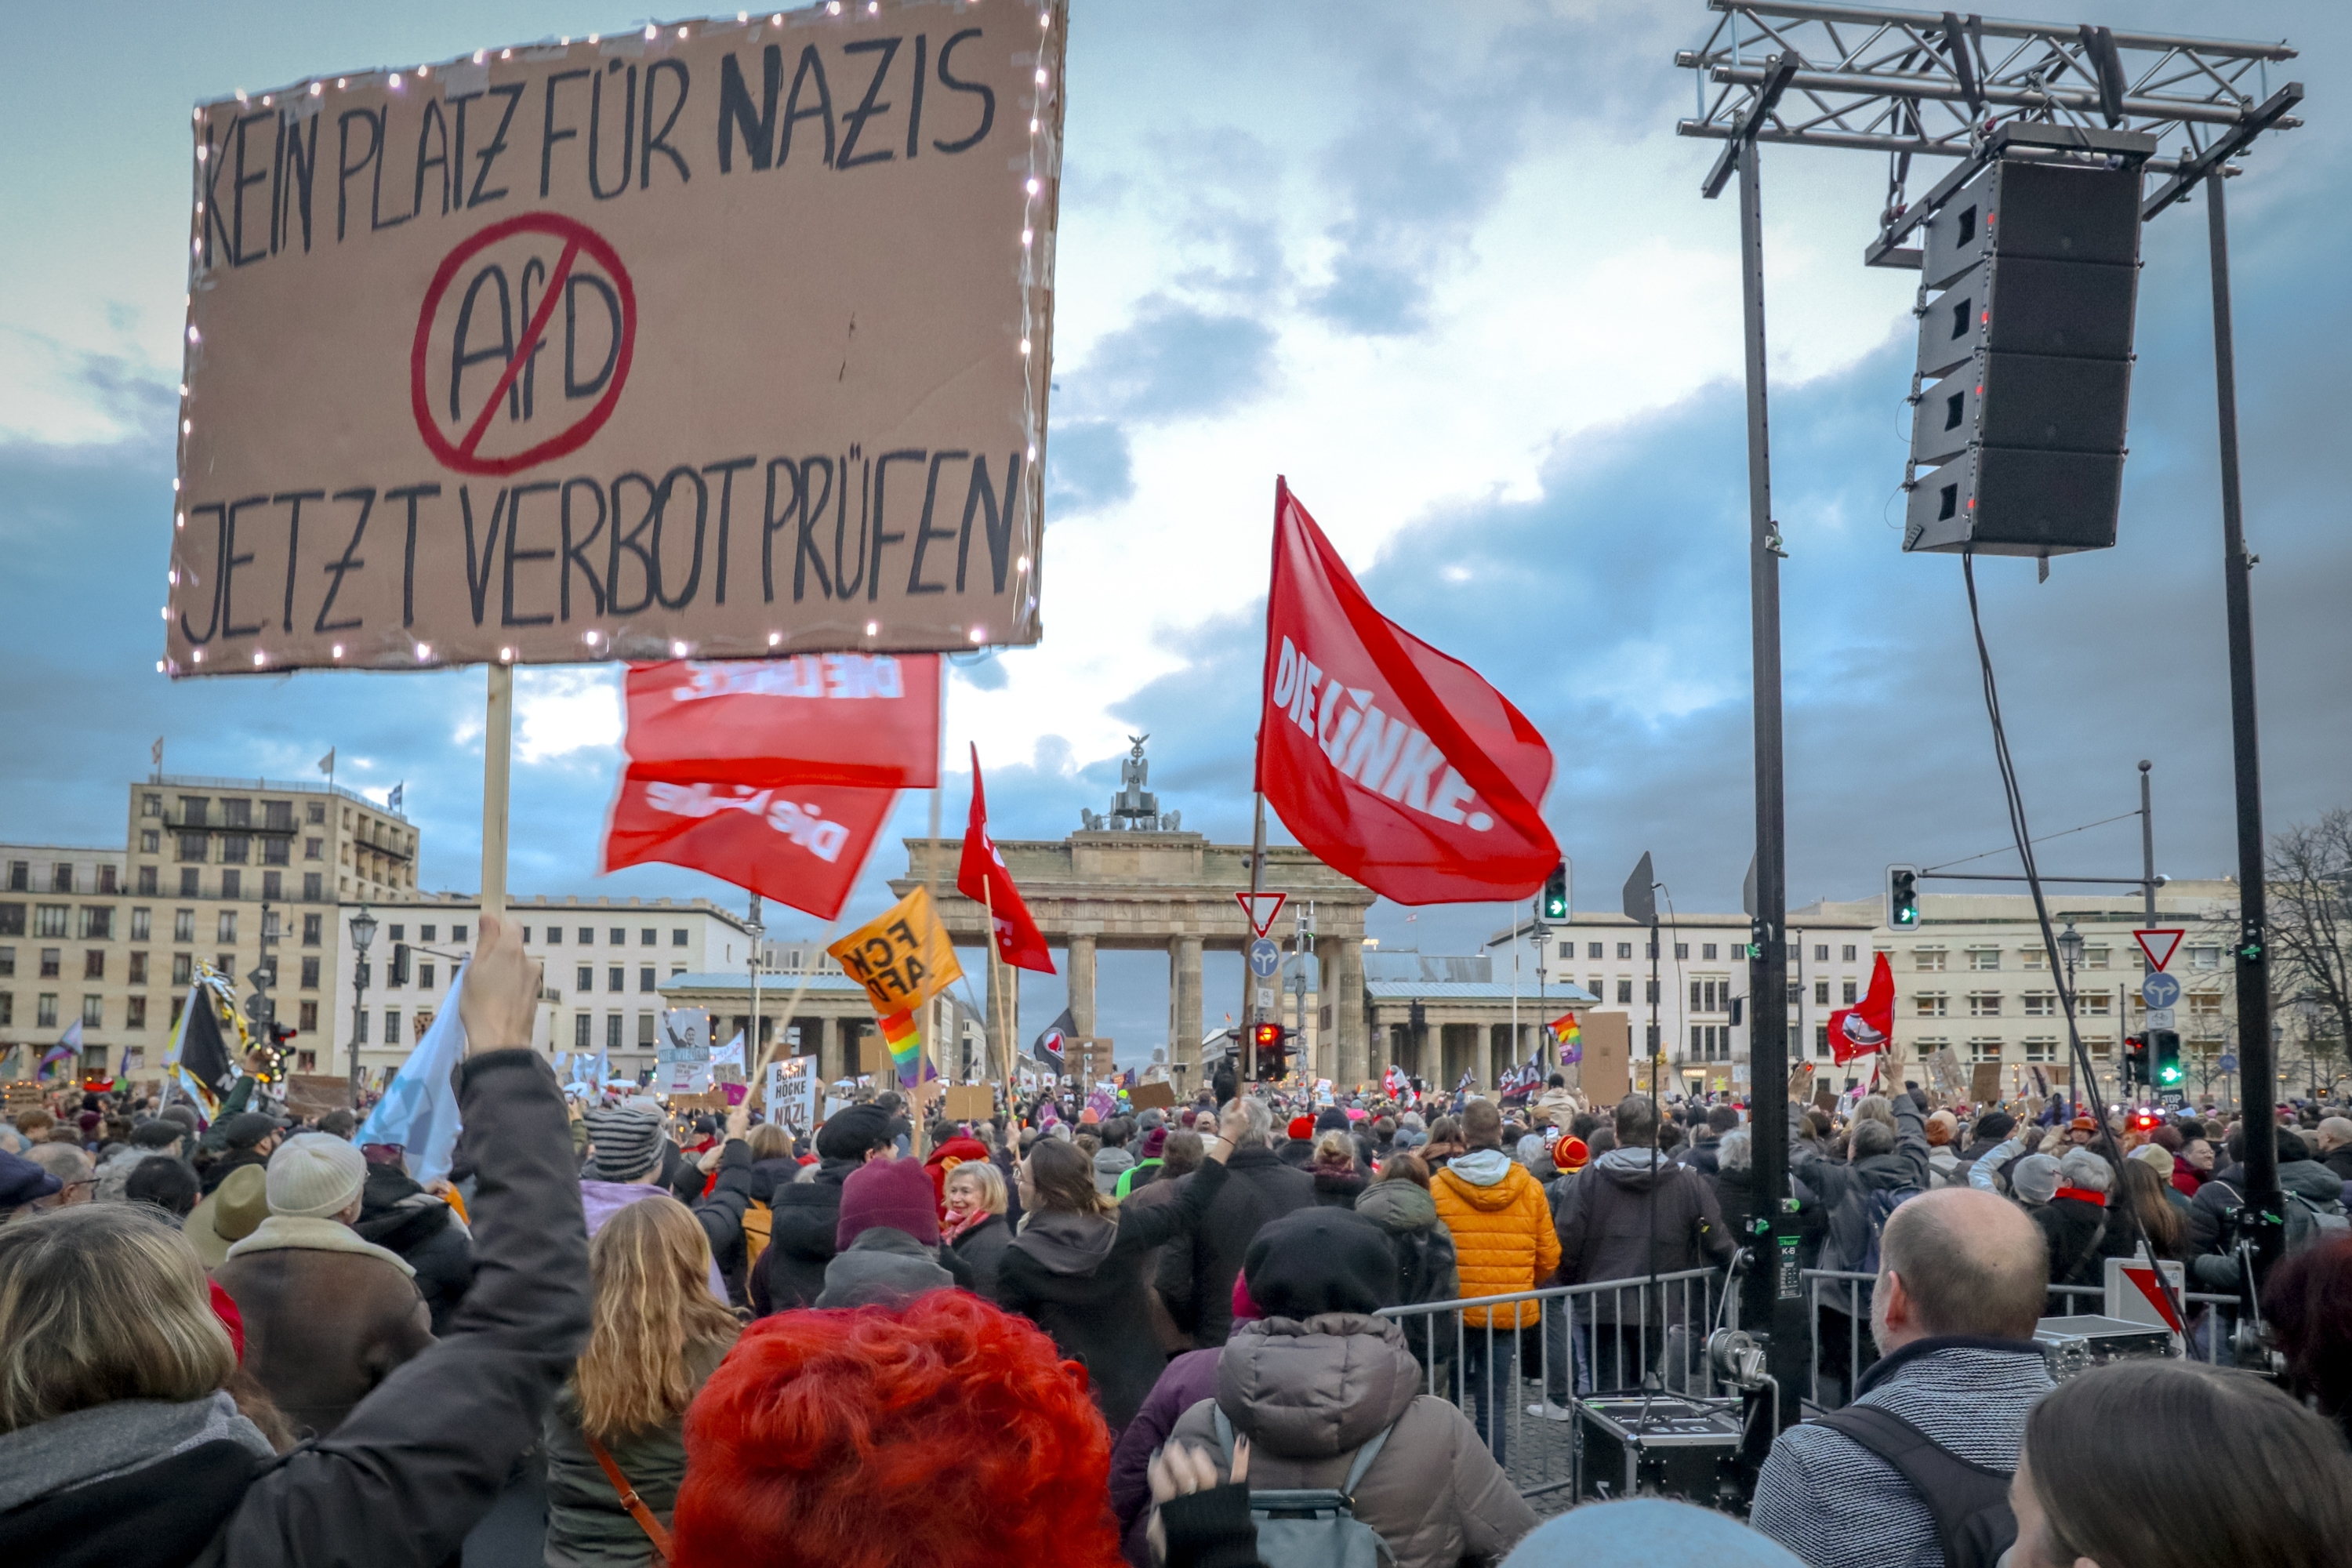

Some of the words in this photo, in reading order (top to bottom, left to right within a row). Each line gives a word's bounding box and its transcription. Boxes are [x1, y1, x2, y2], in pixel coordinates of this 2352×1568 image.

[204, 107, 318, 269] KEIN
[338, 82, 526, 244] PLATZ
[539, 56, 691, 200] FÜR
[717, 28, 996, 174] NAZIS
[450, 256, 625, 423] AfD
[181, 482, 441, 644] JETZT
[459, 455, 757, 626] VERBOT
[762, 442, 1020, 604] PRÜFEN
[1273, 634, 1323, 739] DIE
[775, 1081, 806, 1099] HÖCKE
[775, 1102, 804, 1126] NAZI
[776, 1063, 807, 1082] BJN
